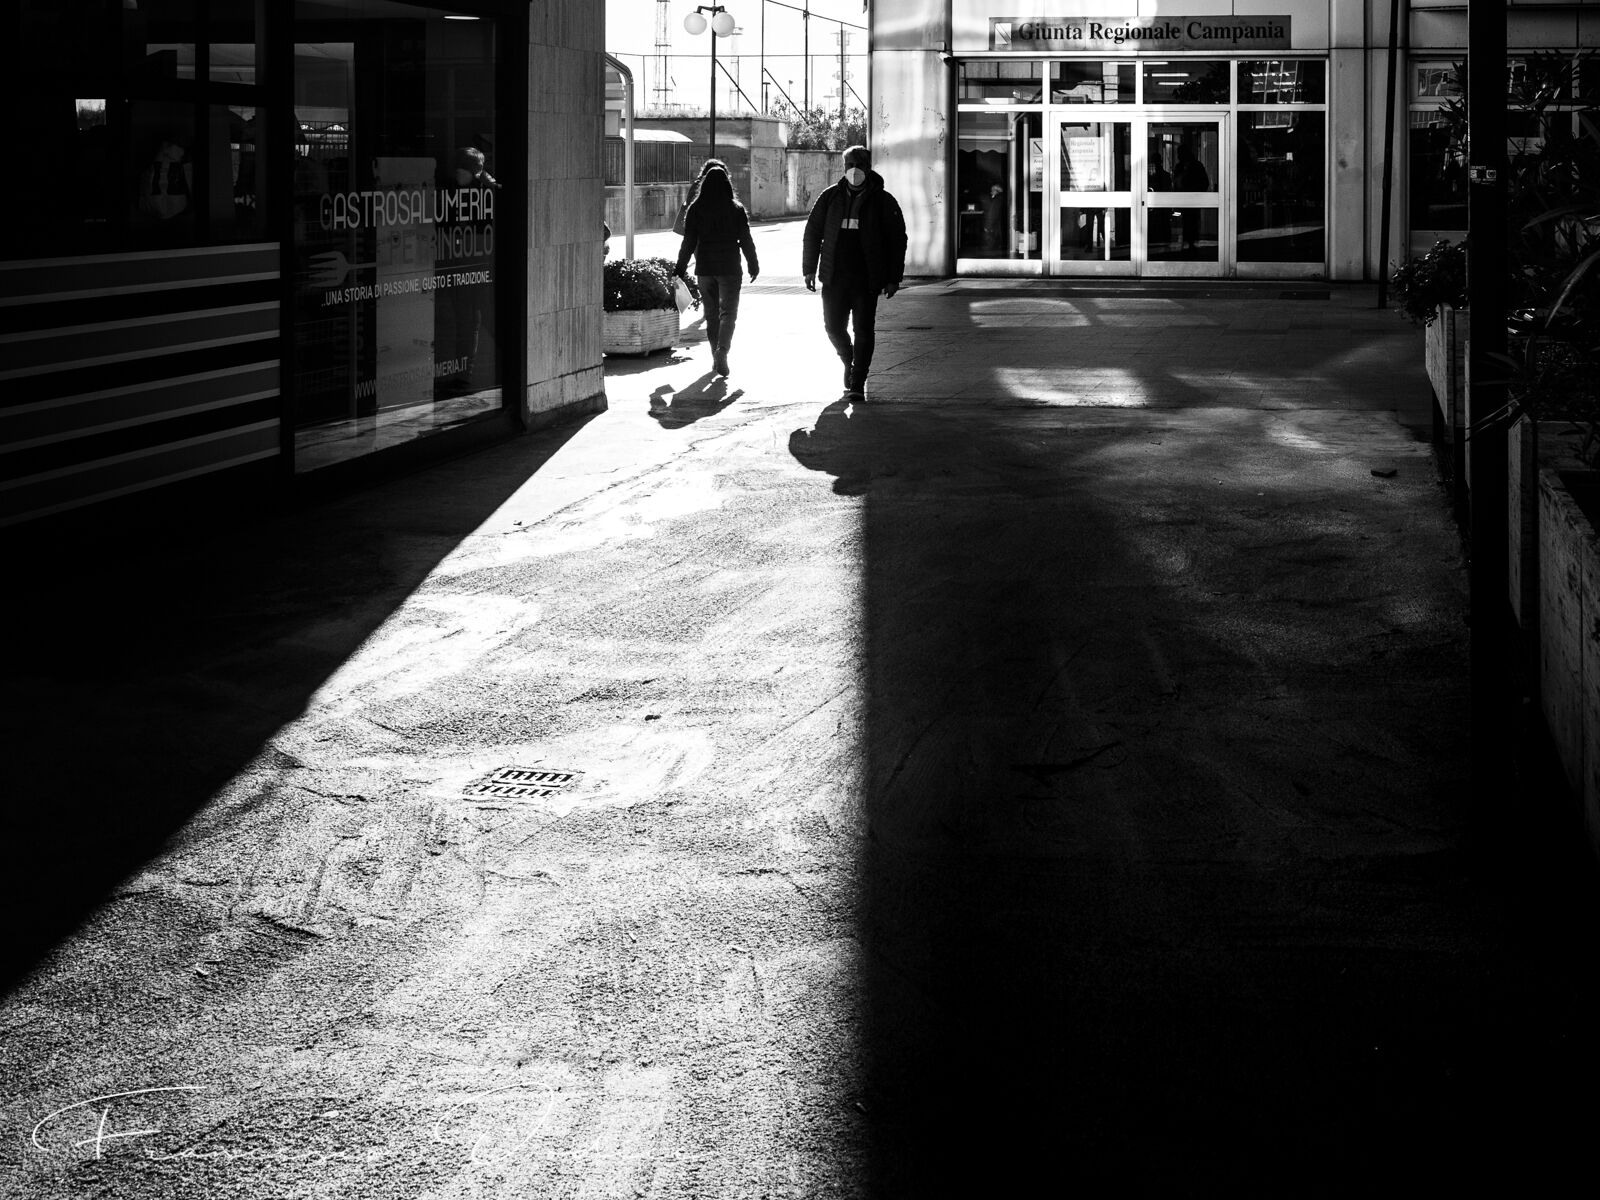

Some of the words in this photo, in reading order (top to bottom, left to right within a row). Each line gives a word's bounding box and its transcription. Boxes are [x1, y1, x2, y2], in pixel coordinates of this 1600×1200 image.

[1018, 22, 1083, 41] Giunta
[1089, 22, 1182, 44] Regionale
[1186, 20, 1285, 43] Campania
[319, 188, 494, 232] GASTROSALUMERIA
[344, 285, 373, 303] STORIA
[374, 283, 382, 298] DI
[422, 275, 446, 291] GUSTO
[447, 274, 452, 287] E
